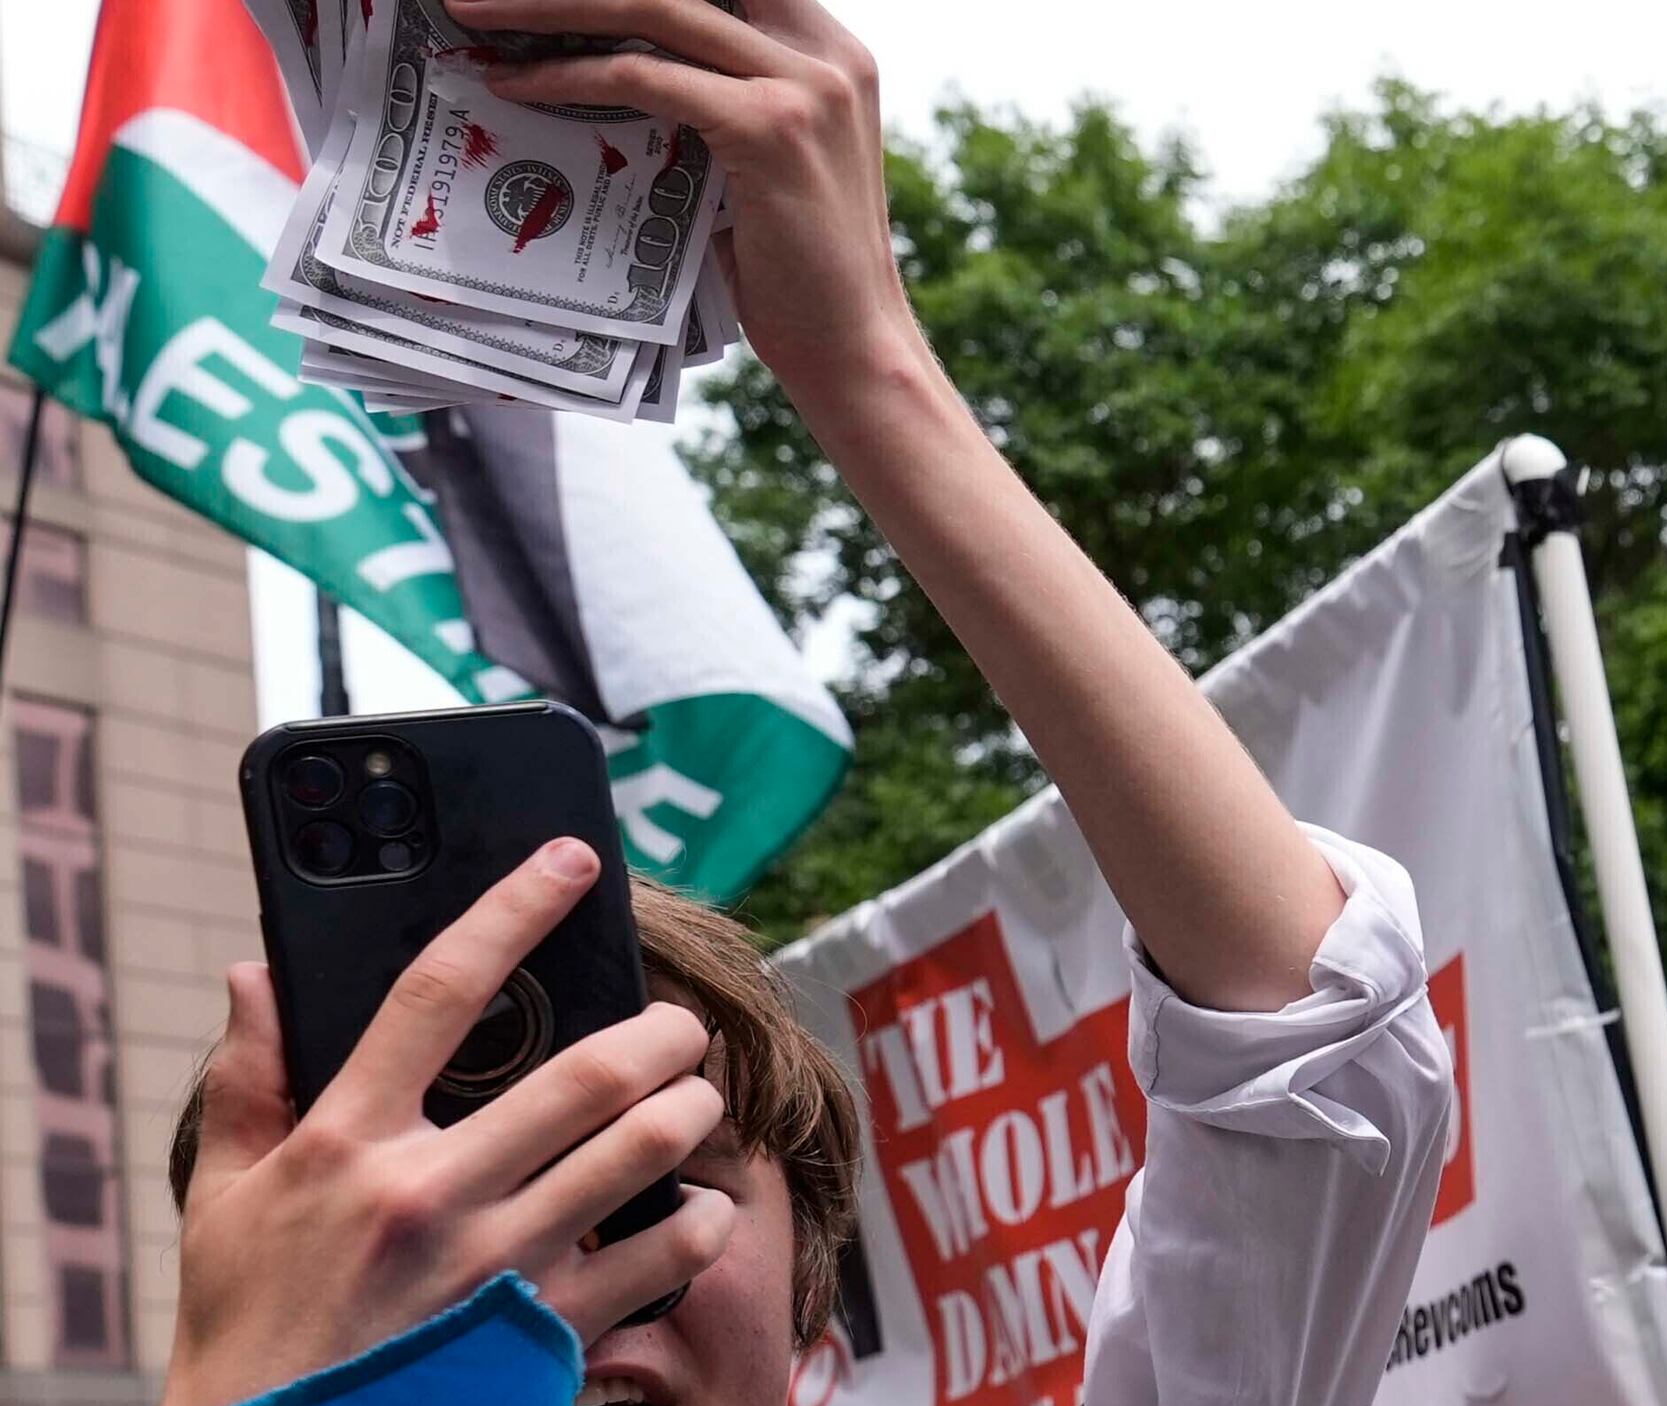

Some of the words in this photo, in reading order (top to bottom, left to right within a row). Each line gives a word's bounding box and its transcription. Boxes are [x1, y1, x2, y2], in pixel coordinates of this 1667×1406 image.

[391, 216, 407, 248] NOT
[402, 146, 426, 215] FEDERAL
[421, 94, 438, 144] RESE
[602, 178, 612, 196] AND
[593, 197, 606, 223] PUBLIC
[575, 248, 585, 264] THIS
[580, 226, 590, 246] NOTE
[587, 185, 602, 215] ILLEGAL
[627, 166, 694, 298] 100
[582, 251, 592, 266] ALL
[578, 268, 587, 283] FOR
